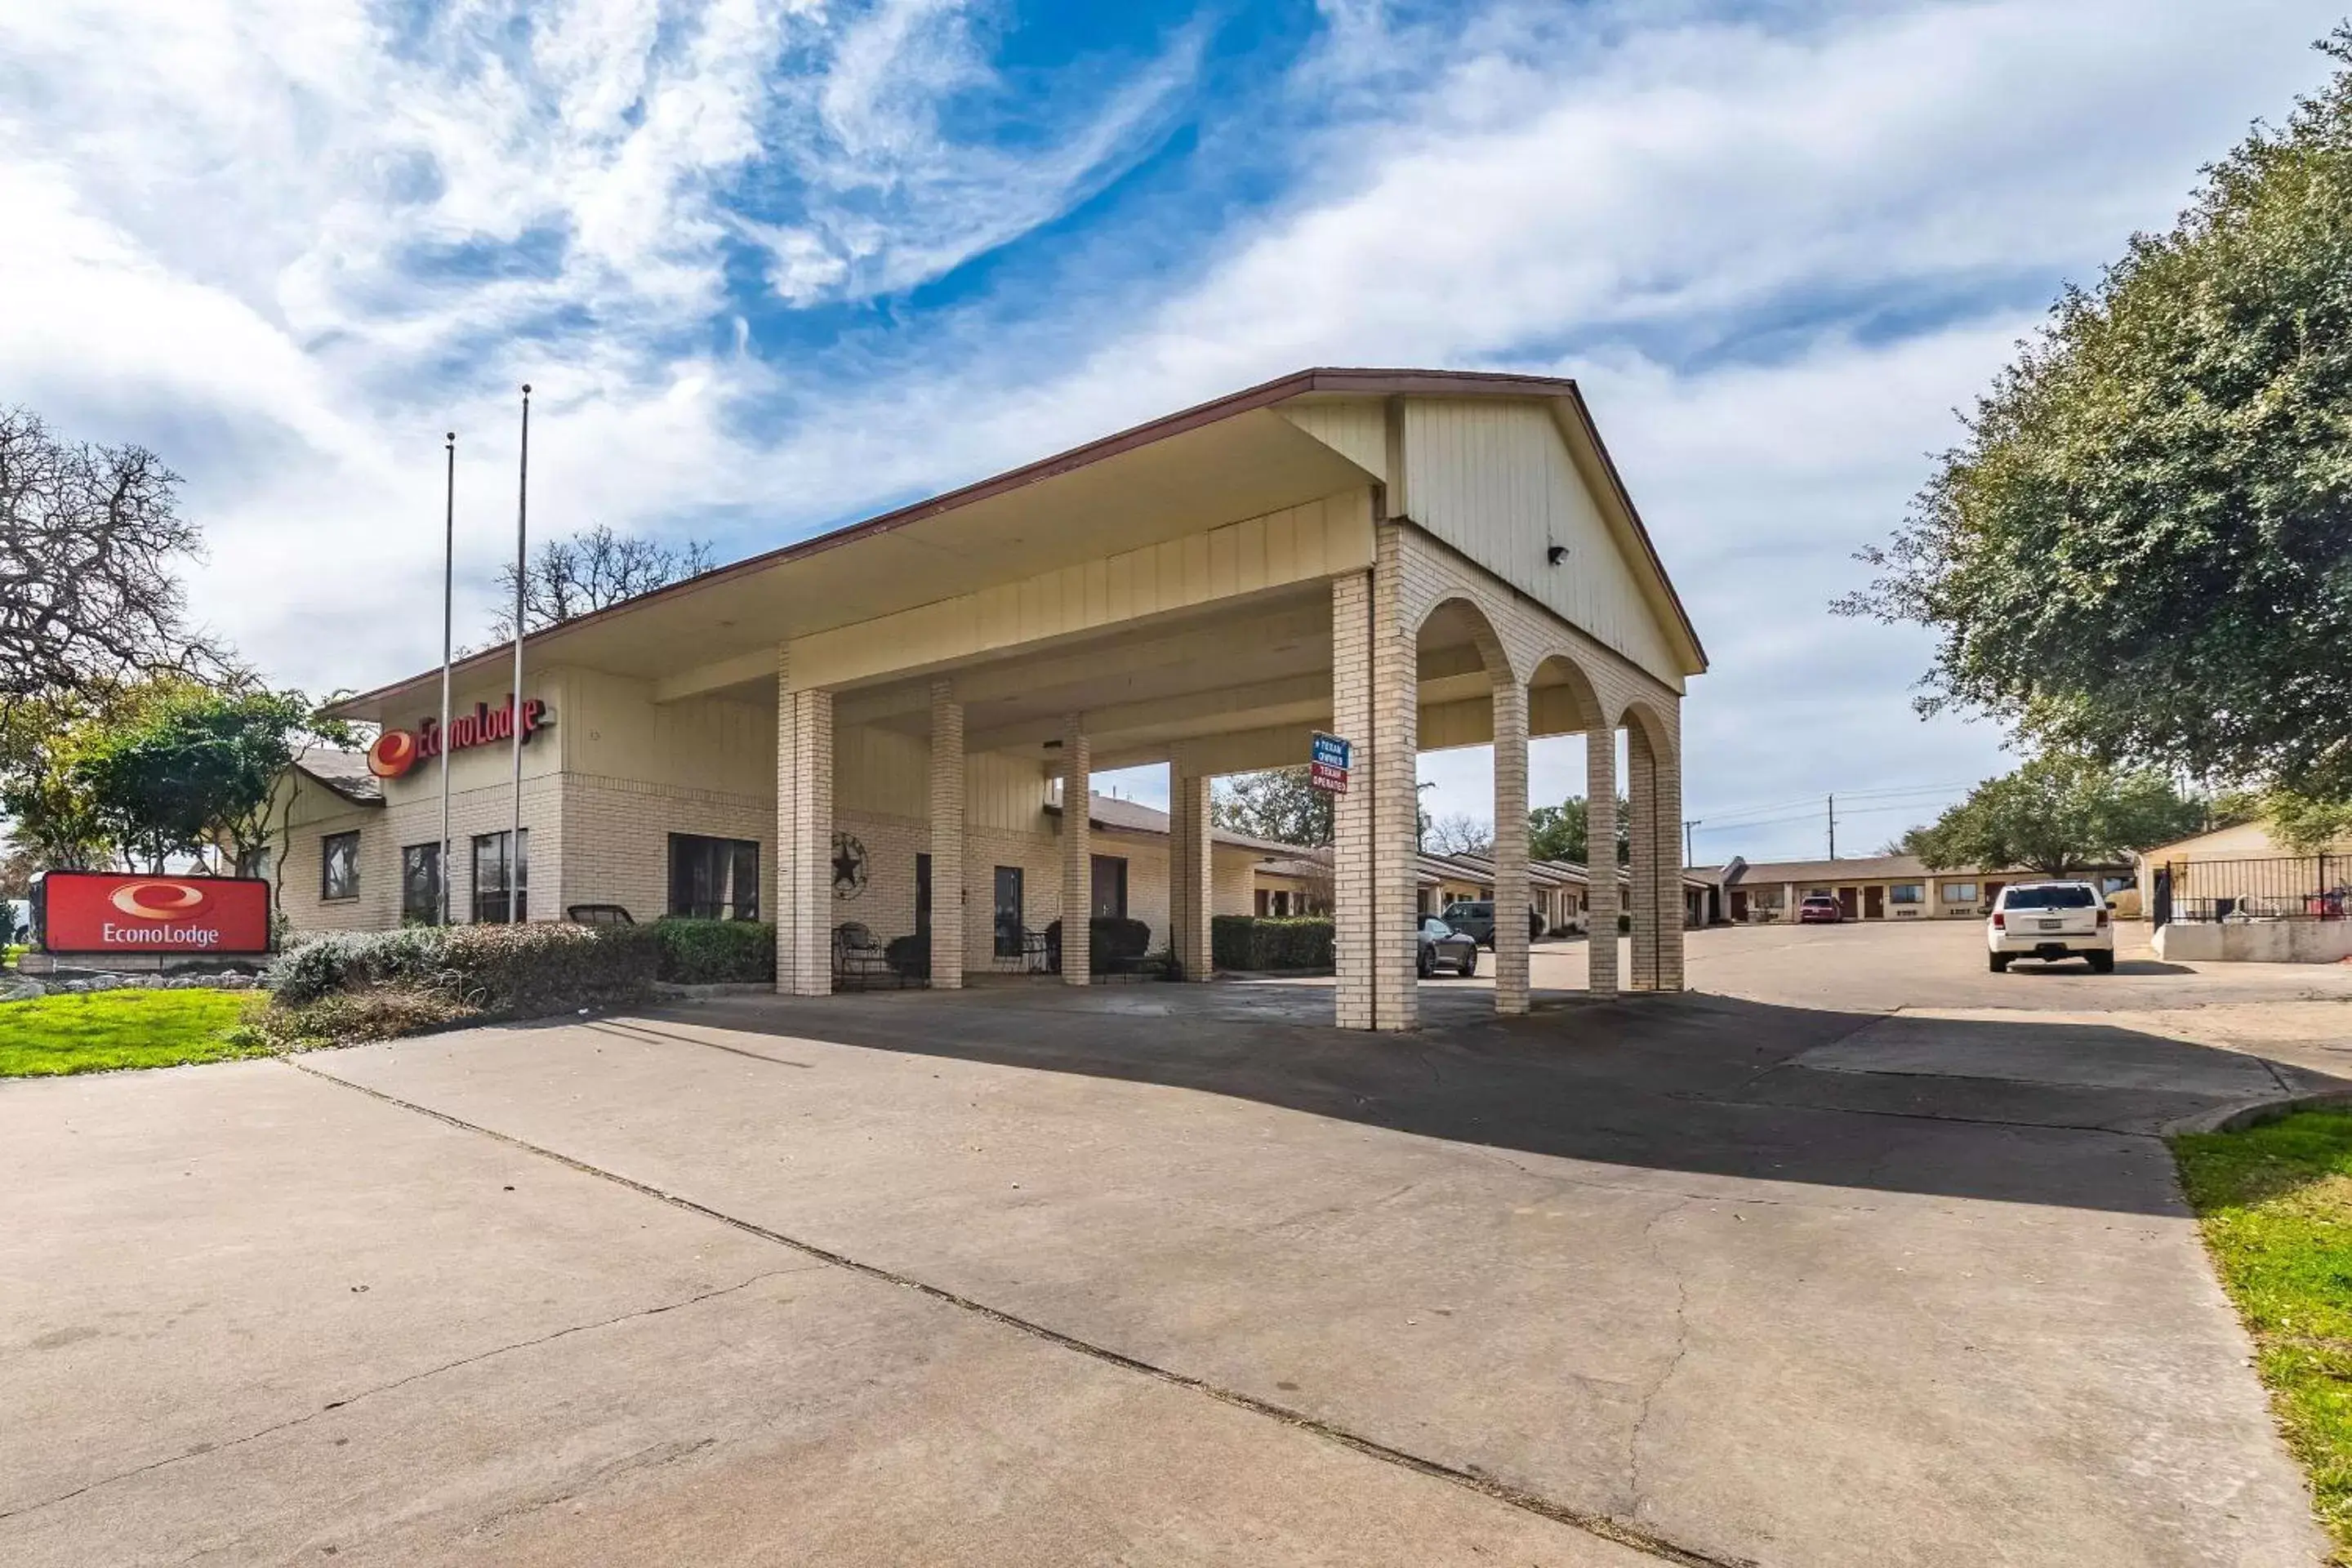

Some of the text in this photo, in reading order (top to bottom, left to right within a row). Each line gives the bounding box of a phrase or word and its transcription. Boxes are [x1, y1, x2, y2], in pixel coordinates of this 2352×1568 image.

[1321, 741, 1341, 754] TEXAN
[1318, 752, 1343, 766] OWNED
[1321, 765, 1341, 778] TEXAN
[1313, 775, 1346, 791] OPERATED
[103, 923, 219, 947] EconoLodge
